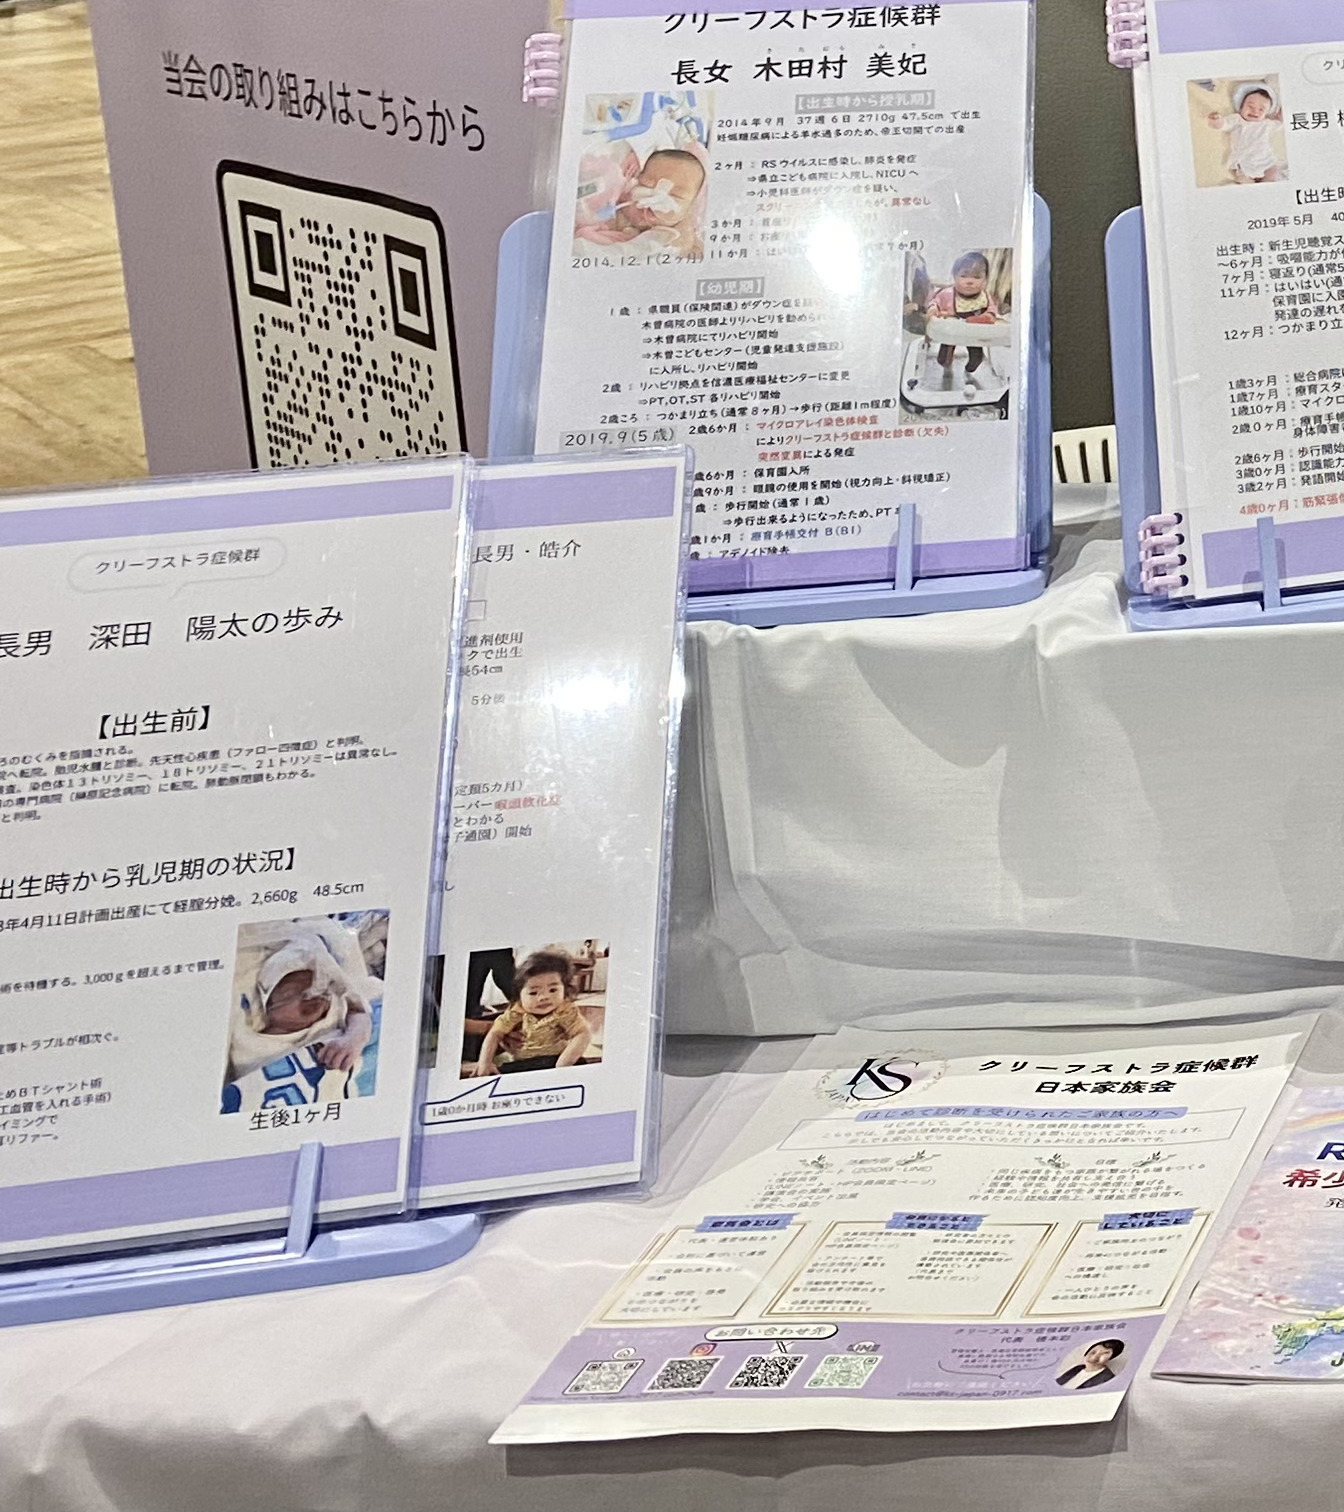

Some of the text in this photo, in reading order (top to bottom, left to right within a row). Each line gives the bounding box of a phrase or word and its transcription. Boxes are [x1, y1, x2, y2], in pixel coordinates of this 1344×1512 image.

[664, 2, 942, 35] クリーフストラ症候群
[671, 50, 928, 84] 長女 木田村 美妃
[162, 50, 486, 152] 当会の取り組みはこちらから
[1290, 111, 1330, 132] 長男
[96, 546, 260, 576] クリーフストラ症候群
[89, 621, 151, 651] 深田
[186, 604, 343, 643] 陽太の歩み
[94, 704, 217, 740] 【出生前】
[250, 880, 364, 906] 2,660g 48.5cm
[978, 1054, 1261, 1076] クリーフストラ症候群
[1034, 1080, 1178, 1095] 日本家族会
[249, 1103, 341, 1132] 生後1ヶ月
